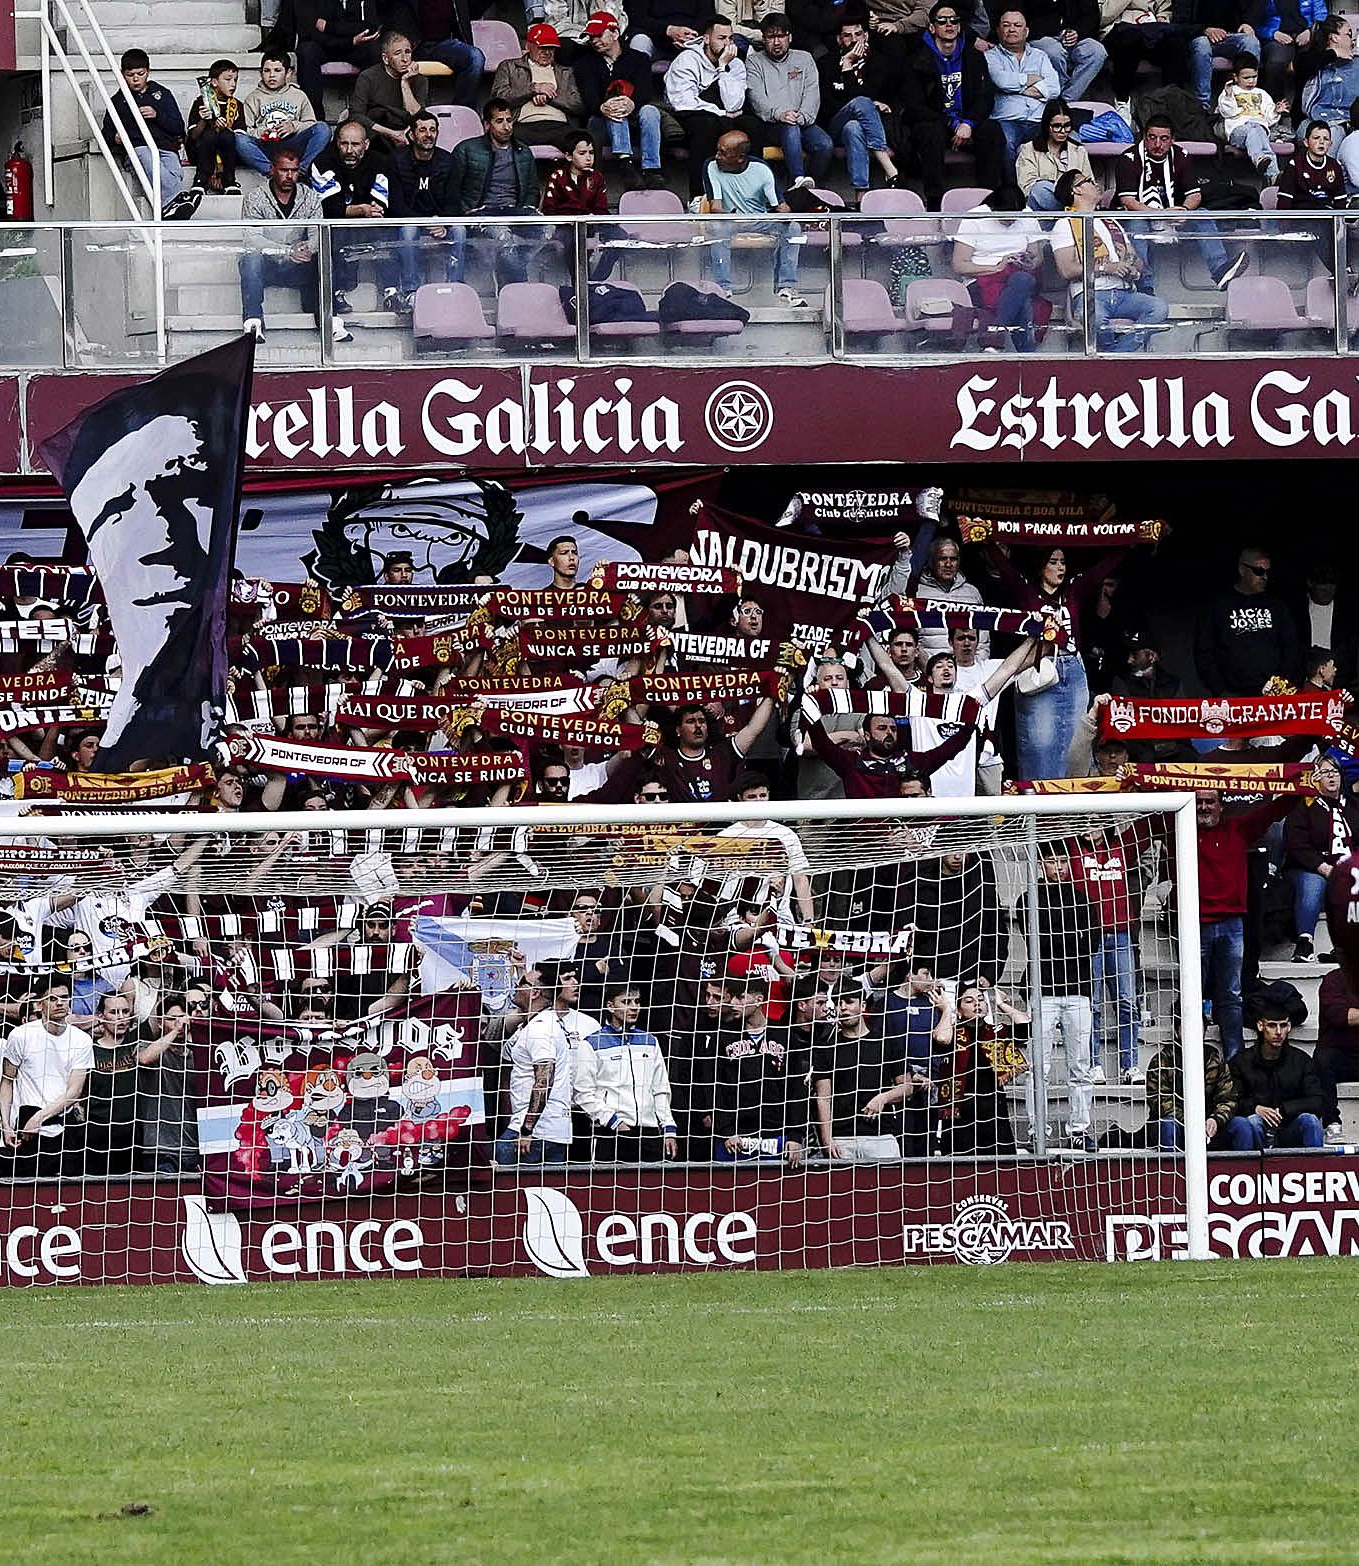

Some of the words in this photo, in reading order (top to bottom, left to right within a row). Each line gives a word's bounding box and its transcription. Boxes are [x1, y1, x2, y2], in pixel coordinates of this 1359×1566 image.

[245, 385, 405, 460] rella
[421, 378, 685, 456] Galicia
[950, 373, 1235, 452] Estrella
[1250, 370, 1359, 448] Ga
[801, 490, 913, 508] PONTEVEDRA
[814, 507, 841, 519] Club
[997, 521, 1020, 533] NON
[1024, 522, 1063, 535] PARAR
[1066, 523, 1088, 535] ATA
[1092, 522, 1137, 535] VOLTAR
[616, 580, 635, 591] CLUB
[373, 592, 480, 608] PONTEVEDRA
[496, 591, 612, 605] PONTEVEDRA
[500, 605, 530, 616] CLUB
[537, 605, 554, 616] DE
[560, 603, 613, 616] FÚTBOL
[534, 627, 640, 641] PONTEVEDRA
[791, 624, 834, 644] MADE
[527, 643, 576, 658] NUNCA
[583, 643, 600, 656] SE
[607, 641, 651, 655] RINDE
[670, 632, 745, 658] NTEVEDRA
[749, 640, 771, 658] CF
[458, 675, 564, 690] PONTEVEDRA
[643, 671, 762, 690] PONTEVEDRA
[21, 686, 68, 702] RINDE
[645, 689, 679, 702] CLUB
[687, 689, 704, 701] DE
[711, 684, 762, 700] FÚTBOL
[490, 698, 550, 711] TEVEDRA
[550, 696, 568, 708] CF
[339, 704, 371, 718] HAI
[377, 704, 419, 722] QUE
[500, 709, 622, 735] PONTEVEDRA
[1139, 705, 1199, 725] FONDO
[1230, 702, 1323, 726] GRANATE
[499, 722, 535, 736] CLUB
[542, 729, 560, 742] DE
[566, 730, 621, 747] FÚTBOL
[270, 748, 348, 766] PONTEVEDRA
[349, 758, 367, 768] CF
[454, 771, 473, 783] SE
[480, 767, 526, 782] RINDE
[1143, 774, 1228, 790] PONTEVEDRA
[1241, 780, 1266, 792] BOA
[1267, 781, 1297, 793] VILA
[57, 788, 137, 801] PONTEVEDRA
[150, 785, 174, 797] BOA
[776, 927, 912, 954] TEVEDRA
[1210, 1171, 1359, 1205] CONSERV
[955, 1193, 1010, 1212] CONSERVAS
[597, 1211, 757, 1266] ence
[903, 1220, 1075, 1253] PESCAMAR
[261, 1220, 425, 1274] ence
